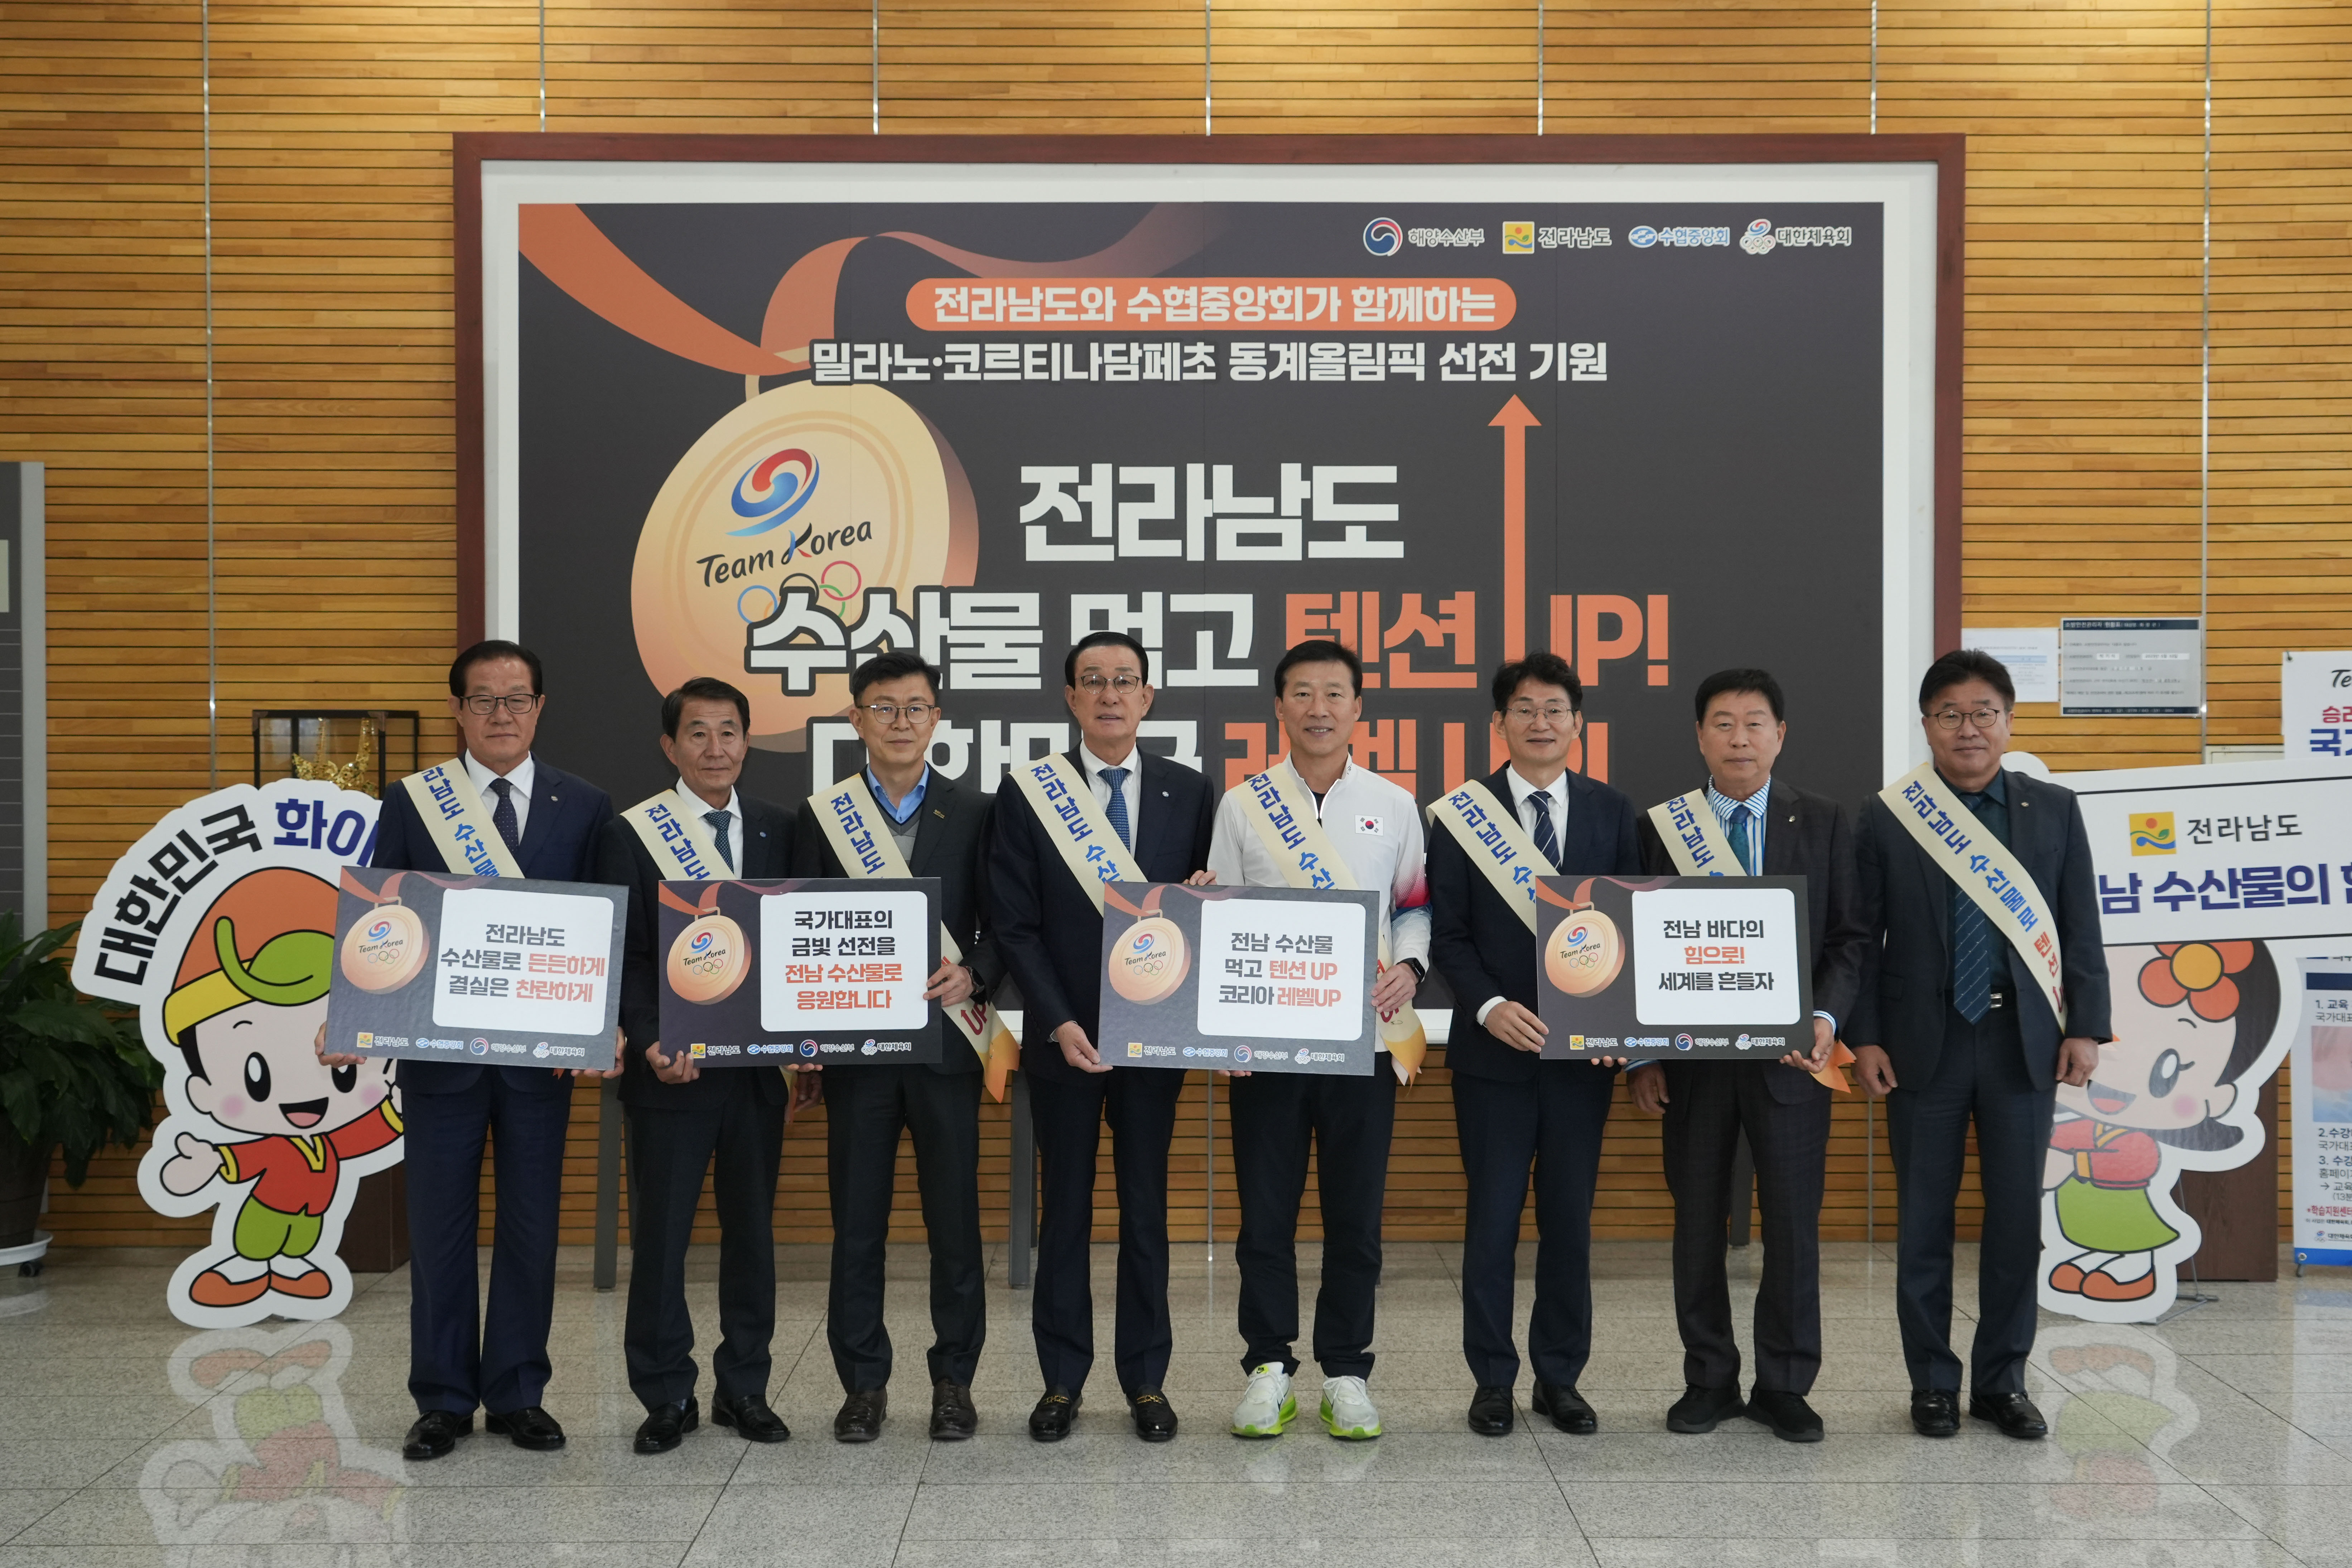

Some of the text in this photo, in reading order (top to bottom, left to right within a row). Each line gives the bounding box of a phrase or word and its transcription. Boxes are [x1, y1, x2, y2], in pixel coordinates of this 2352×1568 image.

[1409, 228, 1485, 247] 해양수산부
[1538, 227, 1611, 248] 전라남도
[1658, 227, 1730, 247] 수협중앙회
[1776, 227, 1852, 247] 대한체육회
[934, 286, 1495, 322] 전라남도와 수협중앙회가 함께하는
[814, 342, 1608, 381] 밀라노·코르티나담페초 동계올림픽 선전 기원
[1020, 463, 1404, 561] 전라남도
[697, 522, 872, 587] Team Korea
[751, 592, 1043, 690] 수산물
[1286, 591, 1478, 689] 텐션
[2332, 670, 2352, 688] Te
[421, 766, 464, 821] 라남도
[1030, 763, 1093, 842] 전라남도
[1248, 773, 1306, 850] 전라남도
[830, 792, 885, 874] 전라남도
[1448, 791, 1517, 865] 전라남도
[1666, 796, 1715, 868] 전라남도
[2187, 814, 2303, 845] 전라남도
[645, 804, 710, 880] 전라남도
[1902, 781, 1972, 854] 전라남도
[1970, 854, 2039, 932] 수산물로
[94, 799, 379, 985] 대한민국 화이
[2099, 873, 2143, 915] 남
[2153, 863, 2331, 912] 수산물의
[795, 910, 892, 930] 국가대표의
[1663, 920, 1764, 939] 전남 바다의
[486, 923, 565, 947] 전라남도
[1231, 932, 1333, 955] 전남 수산물
[358, 939, 403, 954] Team Korea
[792, 936, 895, 957] 금빛 선전을
[1560, 943, 1601, 959] Team Korea
[1684, 946, 1745, 964] 힘으로!
[440, 948, 604, 976] 수산물로 든든하게
[683, 949, 726, 966] Team Korea
[1124, 951, 1166, 966] Team Korea
[785, 963, 902, 984] 전남 수산물로
[1225, 959, 1338, 981] 먹고 텐션 UP
[449, 975, 593, 1002] 결실은 찬란하게
[1659, 972, 1774, 991] 세계를 흔들자
[796, 989, 892, 1010] 응원합니다
[1219, 985, 1274, 1006] 코리아
[2315, 1000, 2349, 1010] 1. 교육
[961, 1003, 987, 1035] UP
[375, 1036, 409, 1048] 전라남도
[430, 1039, 464, 1050] 수협중앙회
[491, 1043, 526, 1054] 해양수산부
[550, 1046, 585, 1057] 대한체육회
[707, 1045, 741, 1056] 전라남도
[760, 1043, 794, 1054] 수협중앙회
[820, 1043, 855, 1053] 해양수산부
[877, 1042, 911, 1052] 대한체육회
[1144, 1046, 1176, 1056] 전라남도
[1586, 1037, 1618, 1048] 전라남도
[1637, 1037, 1669, 1047] 수협중앙회
[1695, 1037, 1729, 1047] 해양수산부
[1751, 1036, 1785, 1047] 대한체육회
[1196, 1047, 1228, 1058] 수협중앙회
[1254, 1050, 1288, 1060] 해양수산부
[1310, 1052, 1345, 1062] 대한체육회
[2319, 1140, 2352, 1151] 국가대
[2319, 1156, 2328, 1164] 3.
[2319, 1168, 2352, 1179] 홈페이
